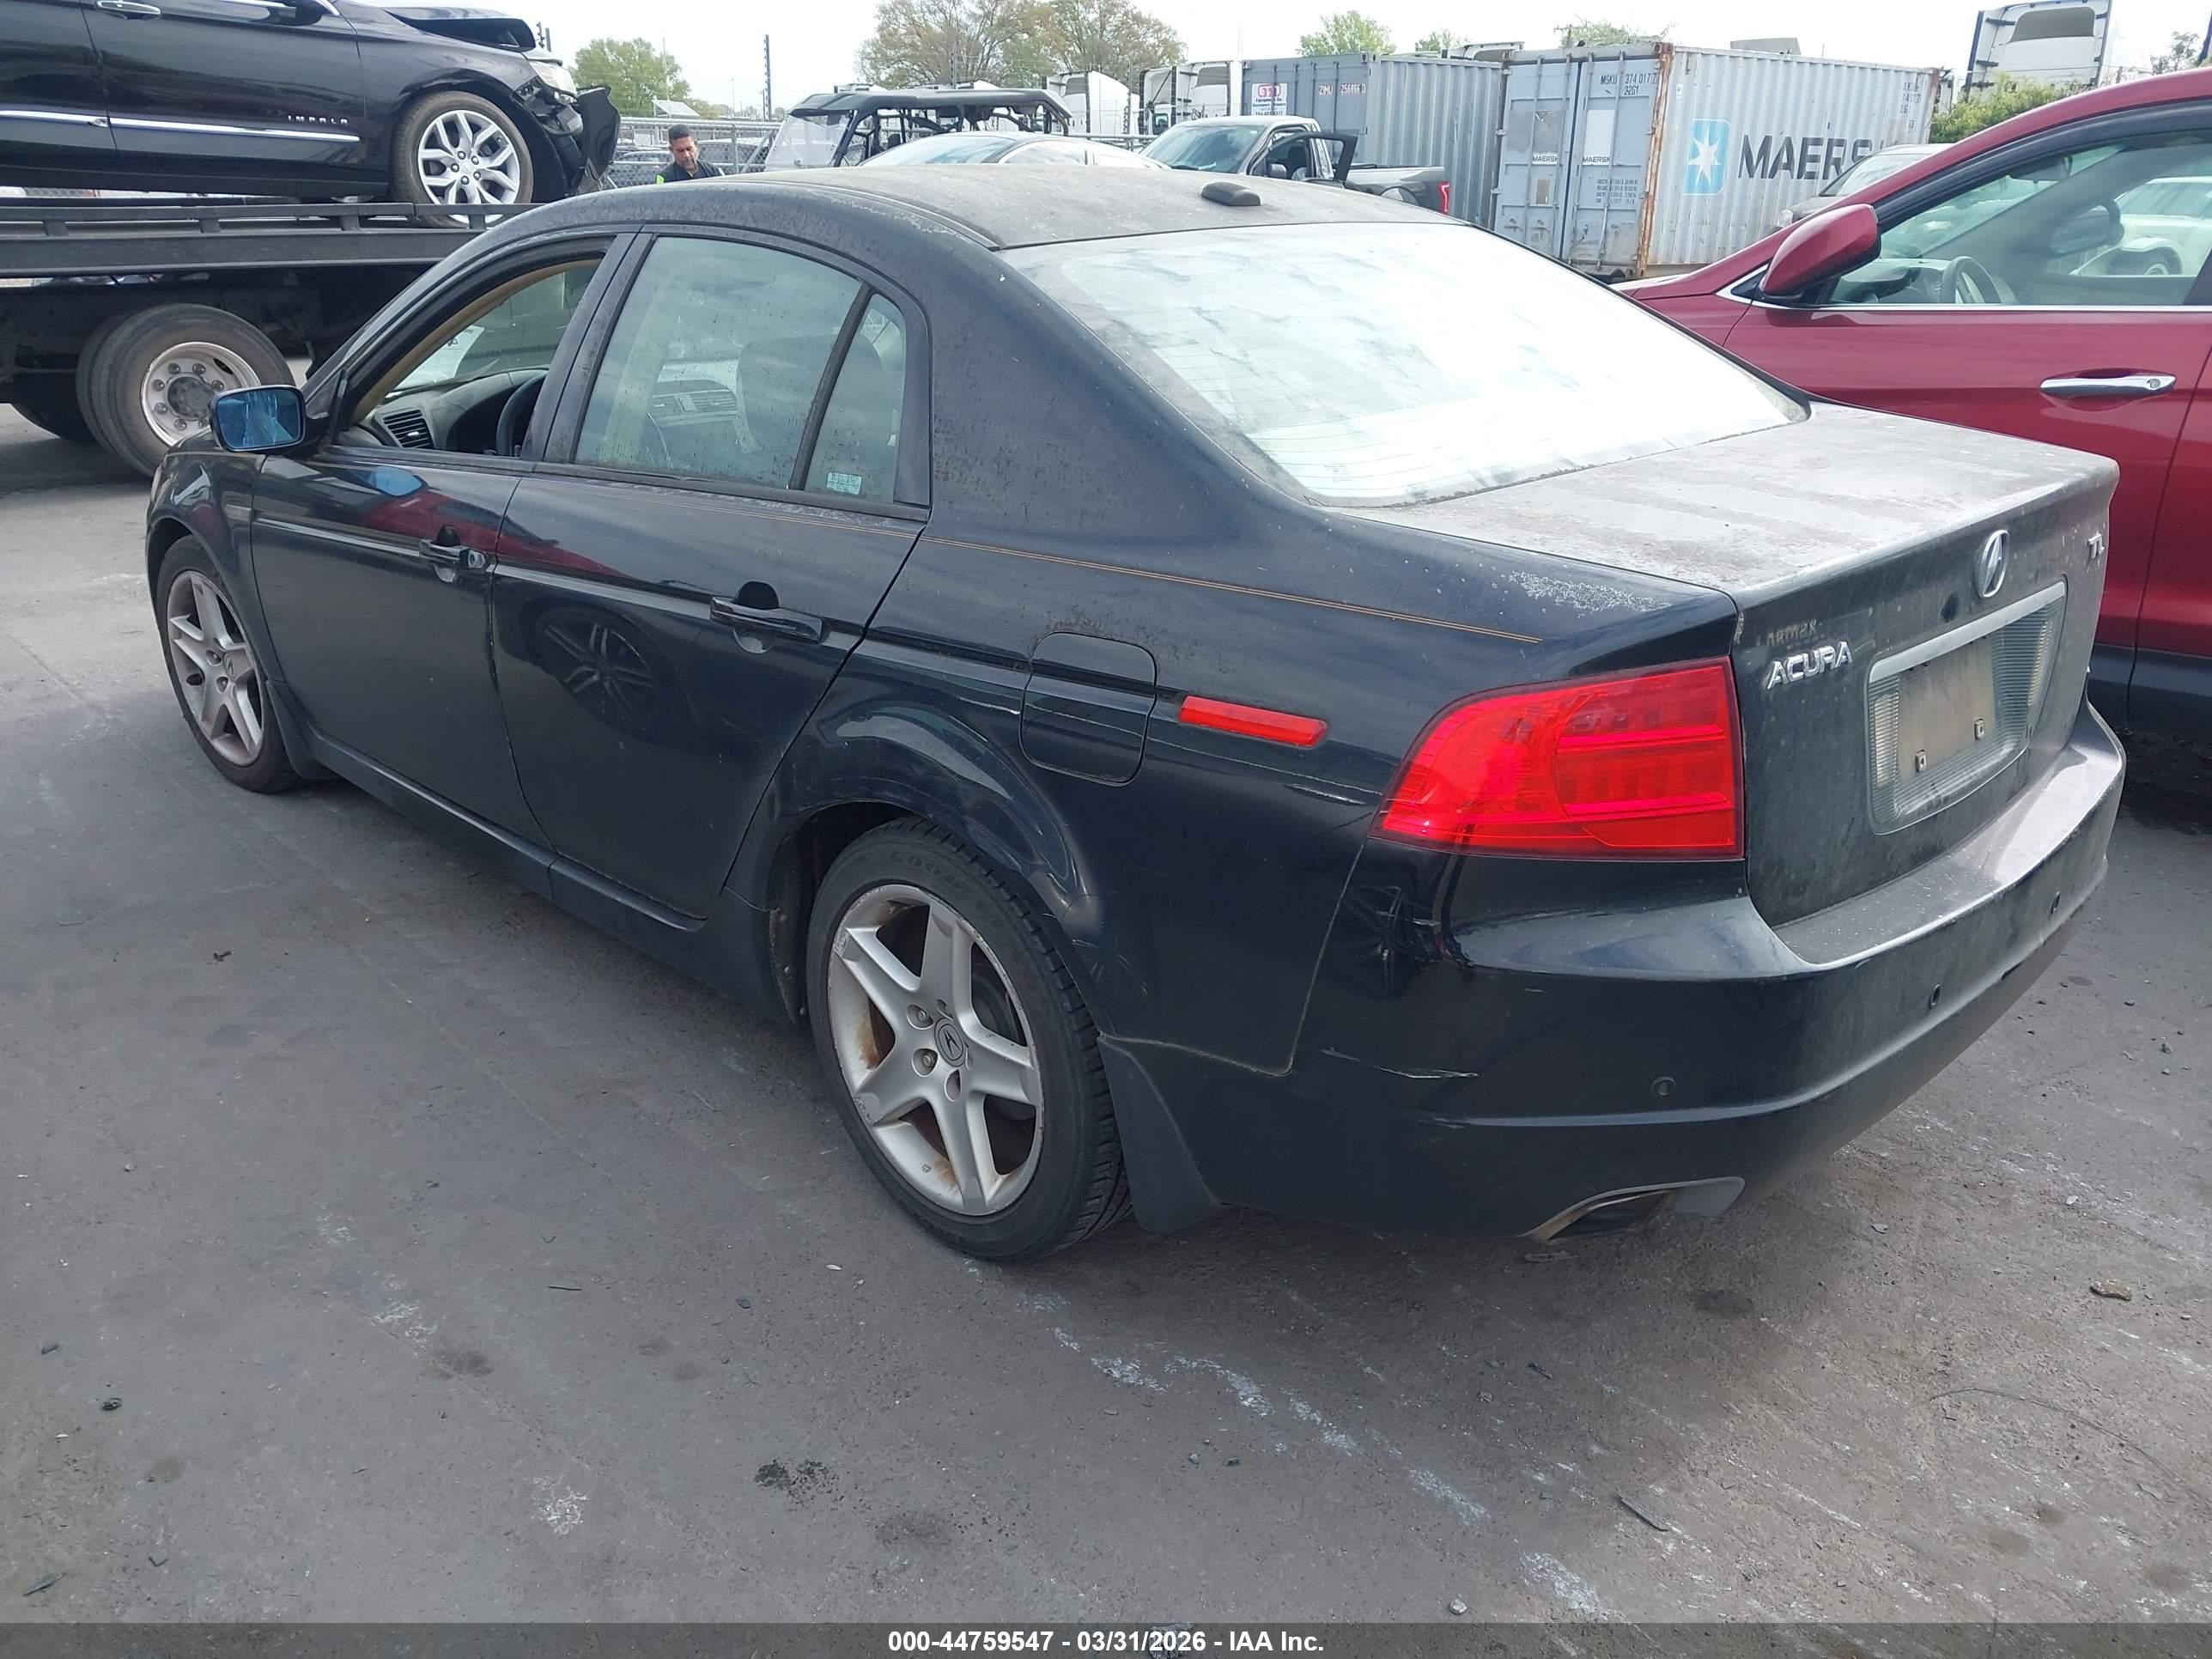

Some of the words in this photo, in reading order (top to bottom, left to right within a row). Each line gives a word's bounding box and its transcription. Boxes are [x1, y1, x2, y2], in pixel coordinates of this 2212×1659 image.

[1600, 74, 1618, 85] MSKU
[1625, 74, 1638, 84] 374
[1638, 73, 1651, 84] 017
[1319, 85, 1334, 96] ZIMU
[1624, 85, 1639, 95] 22G1
[288, 114, 348, 125] IMPALA
[1737, 134, 1884, 180] MAERS
[1766, 641, 1853, 690] ACURA
